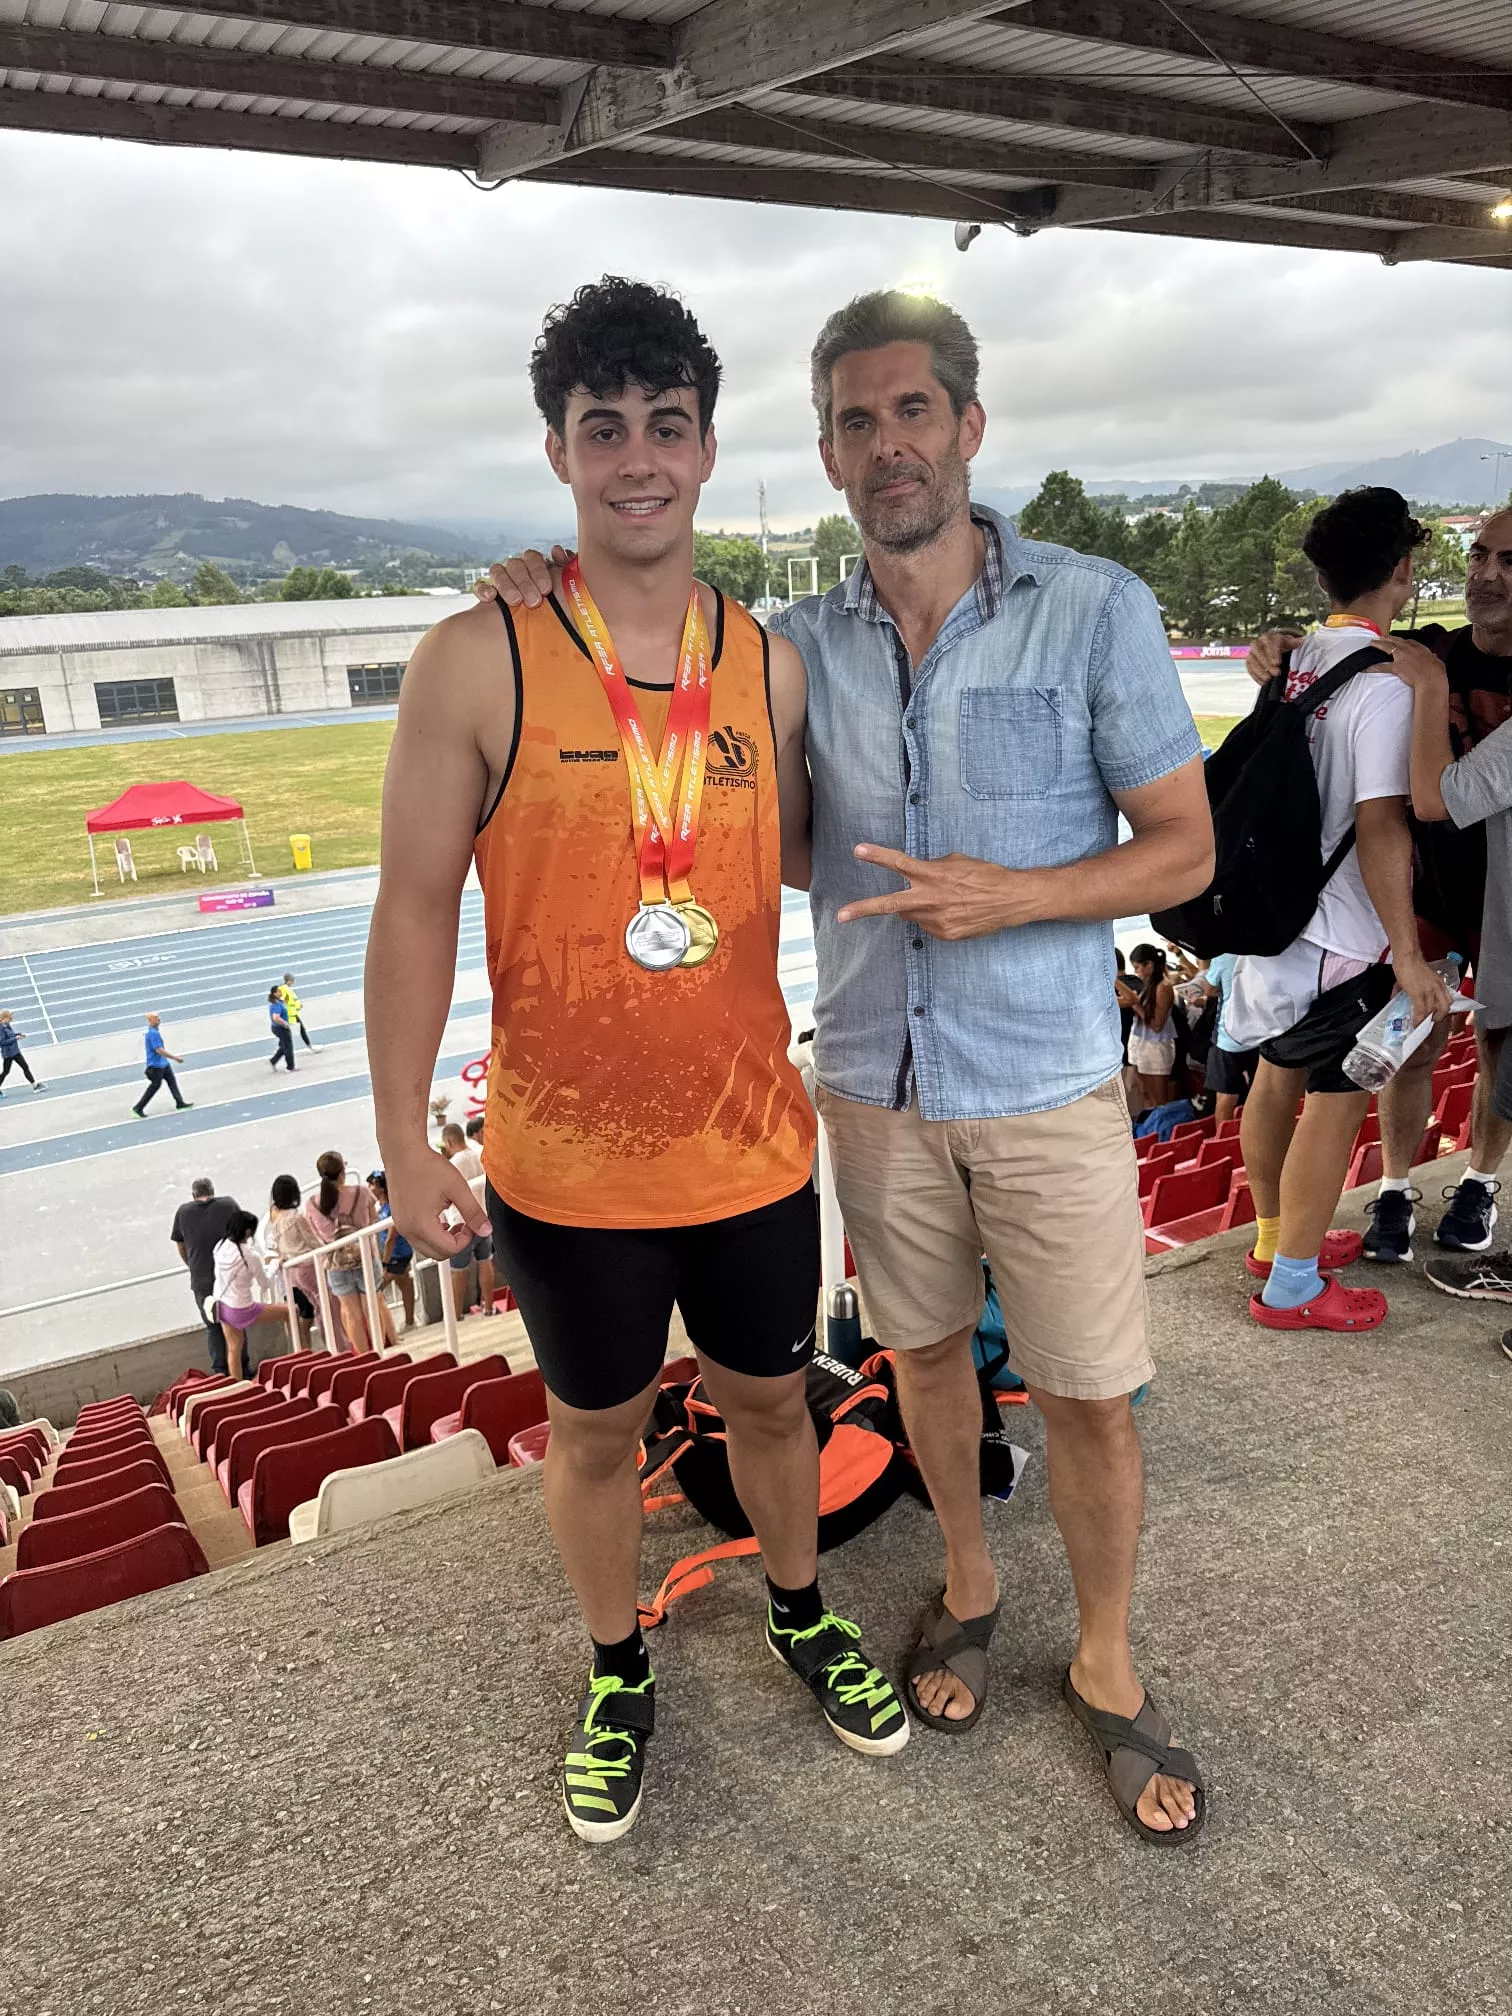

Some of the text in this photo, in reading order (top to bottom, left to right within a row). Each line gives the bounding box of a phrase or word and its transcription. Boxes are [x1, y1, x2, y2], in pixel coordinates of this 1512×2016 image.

[568, 579, 598, 637] ATLETISMO
[627, 718, 655, 787] ATLETISMO
[687, 730, 702, 800] ATLETISMO
[811, 1354, 864, 1387] RUBEN
